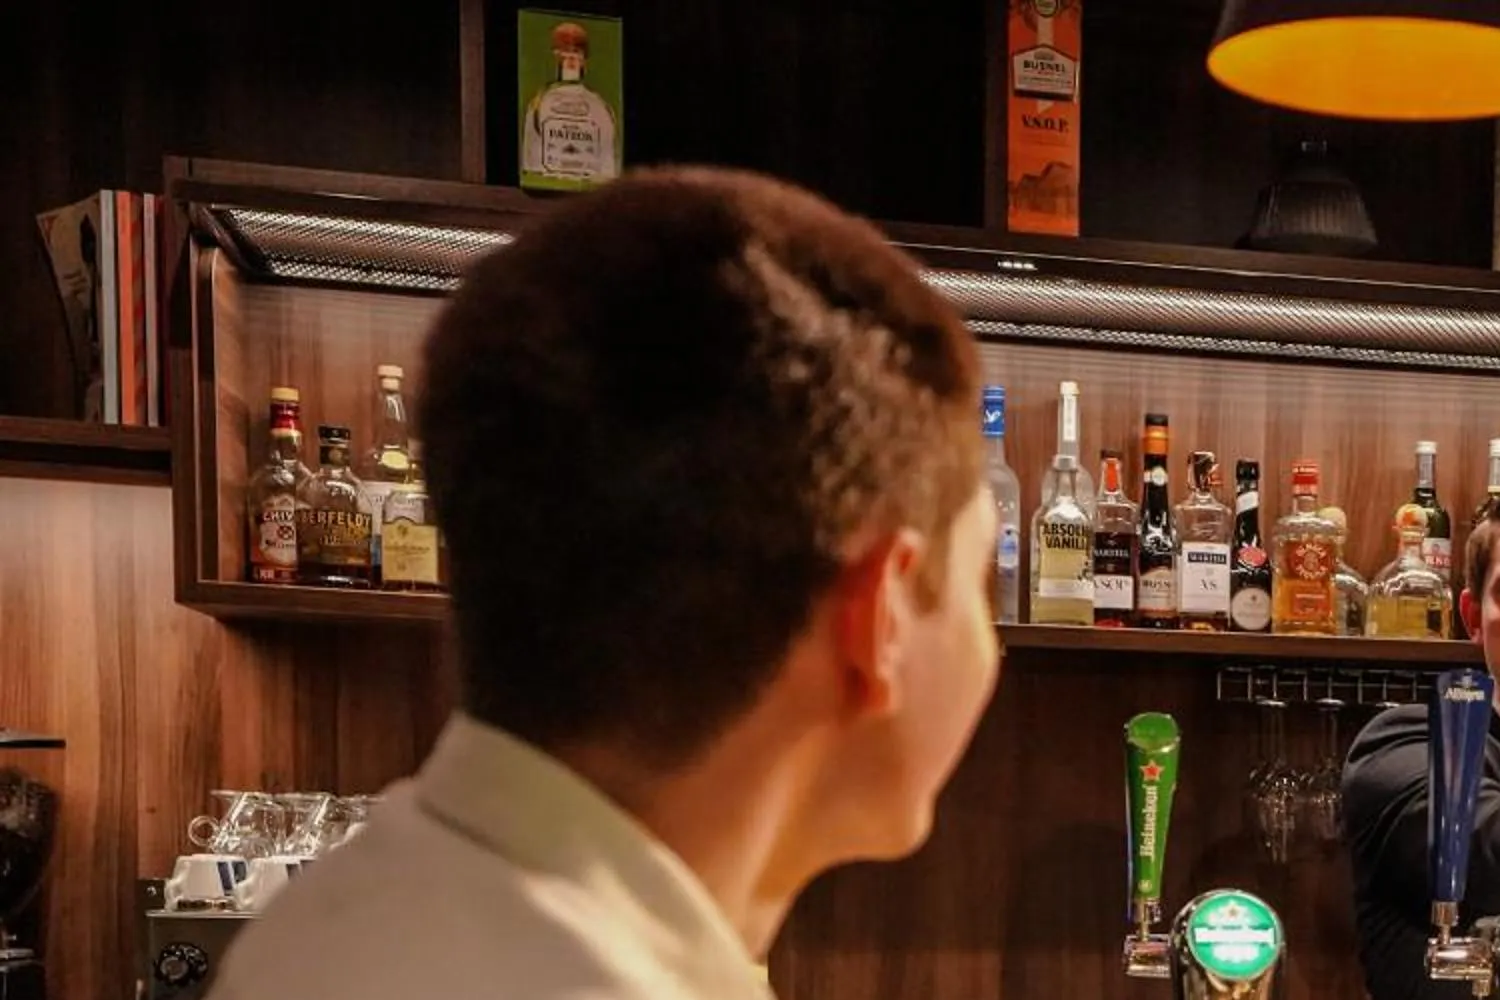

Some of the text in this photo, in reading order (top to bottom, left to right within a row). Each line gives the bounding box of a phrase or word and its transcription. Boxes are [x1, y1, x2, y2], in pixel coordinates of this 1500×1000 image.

[262, 511, 294, 522] CHIV
[1042, 522, 1090, 536] ABSOLU
[1045, 535, 1090, 550] VANILI
[1140, 784, 1158, 862] Heineken
